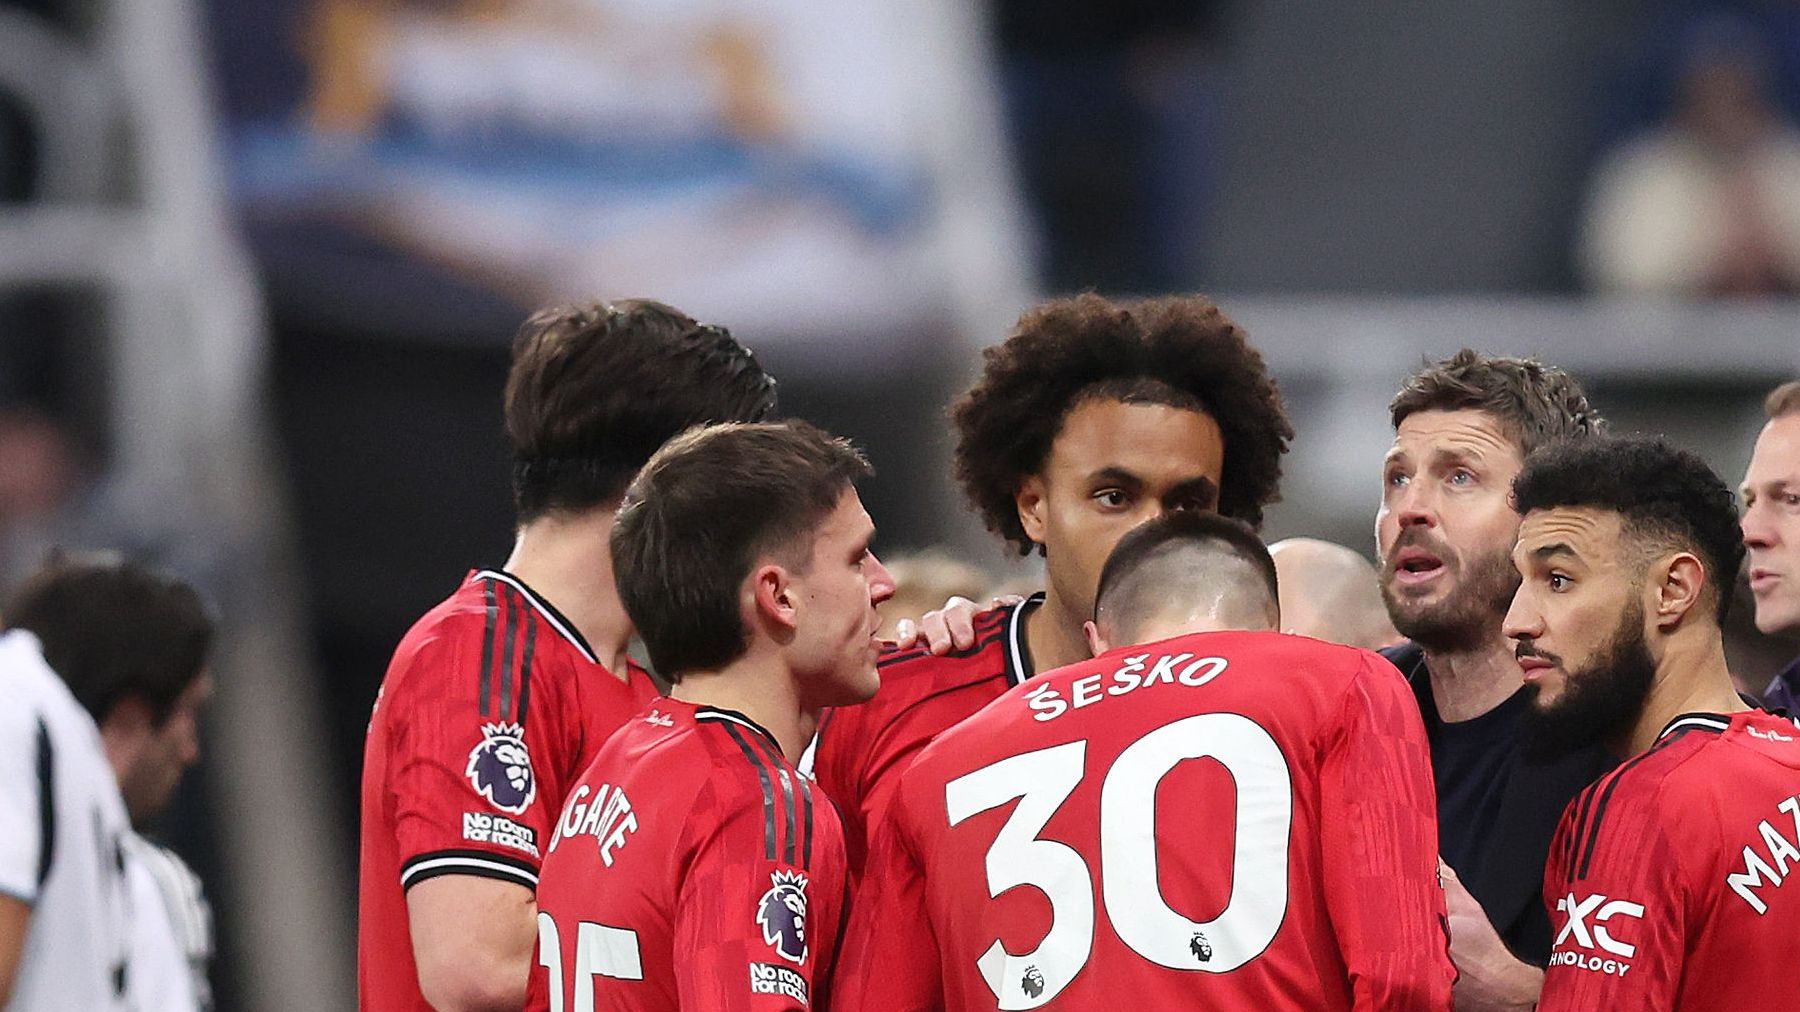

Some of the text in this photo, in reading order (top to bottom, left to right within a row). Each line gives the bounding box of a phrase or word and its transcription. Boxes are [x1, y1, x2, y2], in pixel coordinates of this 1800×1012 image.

[1023, 653, 1229, 723] ŠEŠKO
[463, 812, 492, 831] No
[945, 711, 1293, 1012] 30
[749, 962, 777, 981] No
